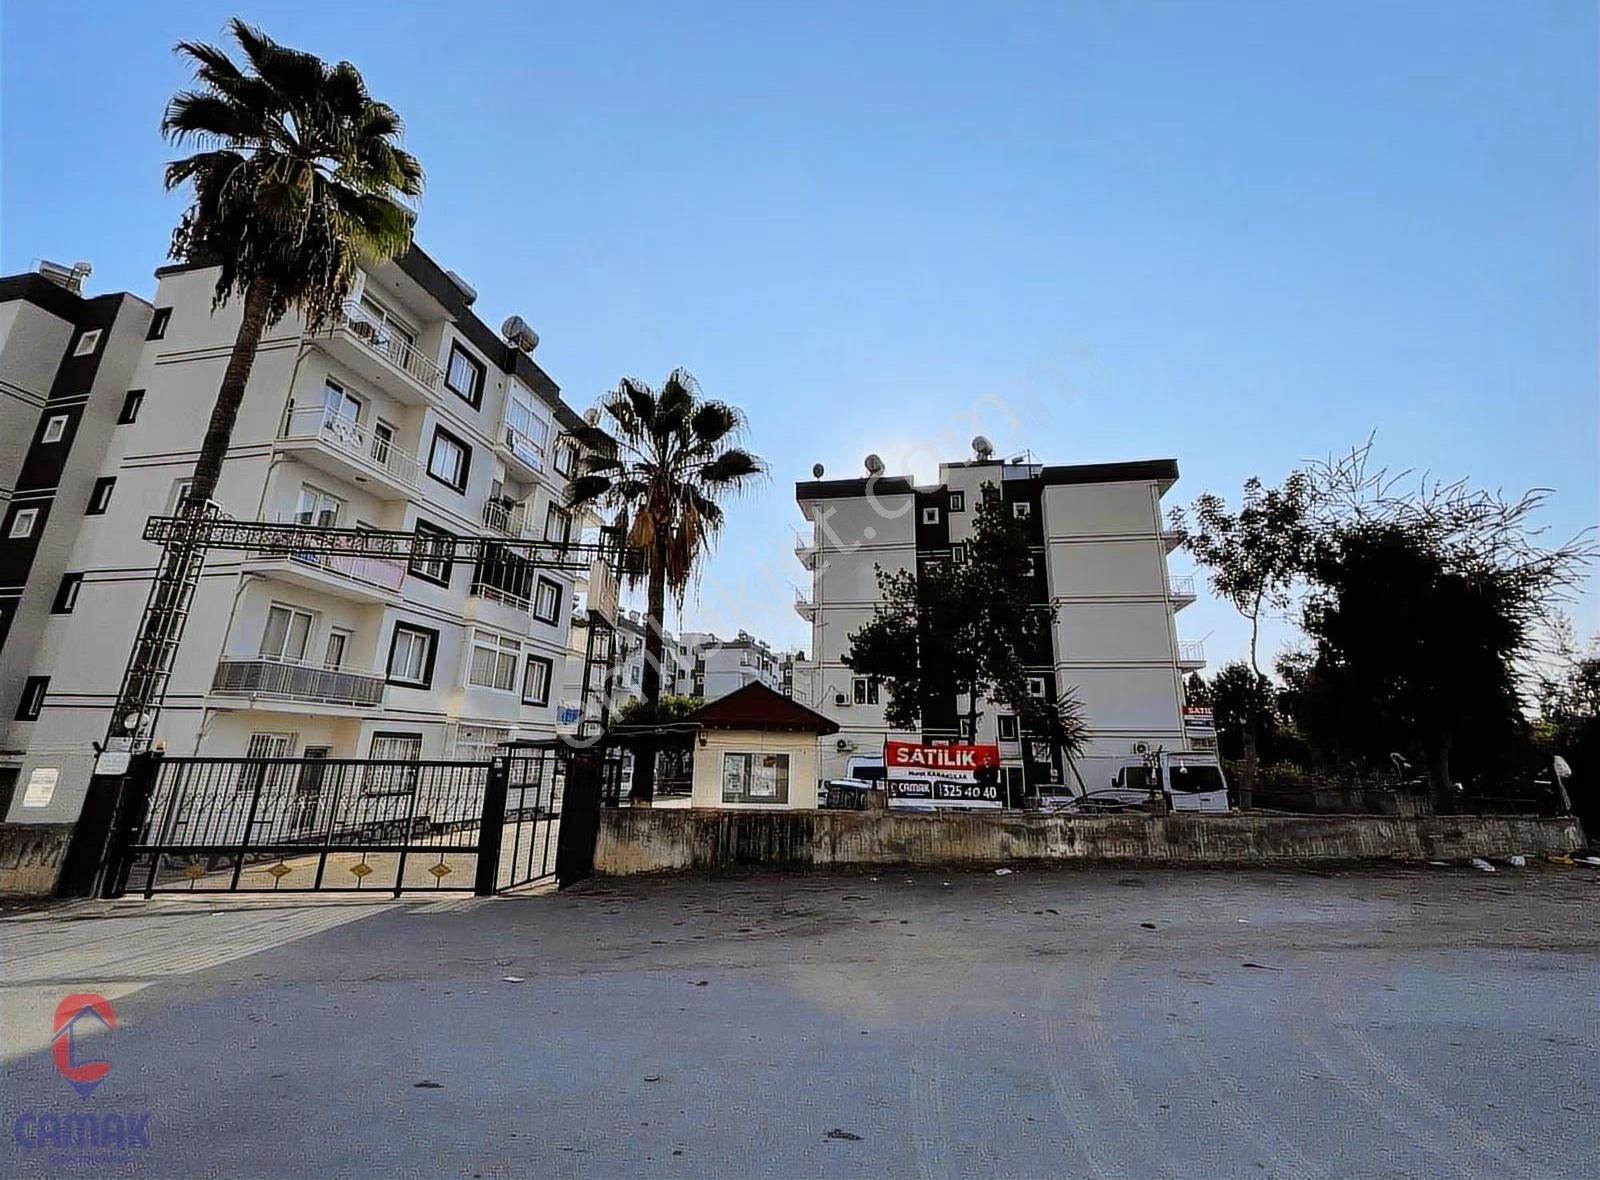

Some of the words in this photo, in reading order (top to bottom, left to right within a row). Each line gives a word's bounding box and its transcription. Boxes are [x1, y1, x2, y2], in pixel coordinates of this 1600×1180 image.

[943, 784, 962, 797] 325
[964, 786, 981, 798] 40
[983, 786, 997, 799] 40
